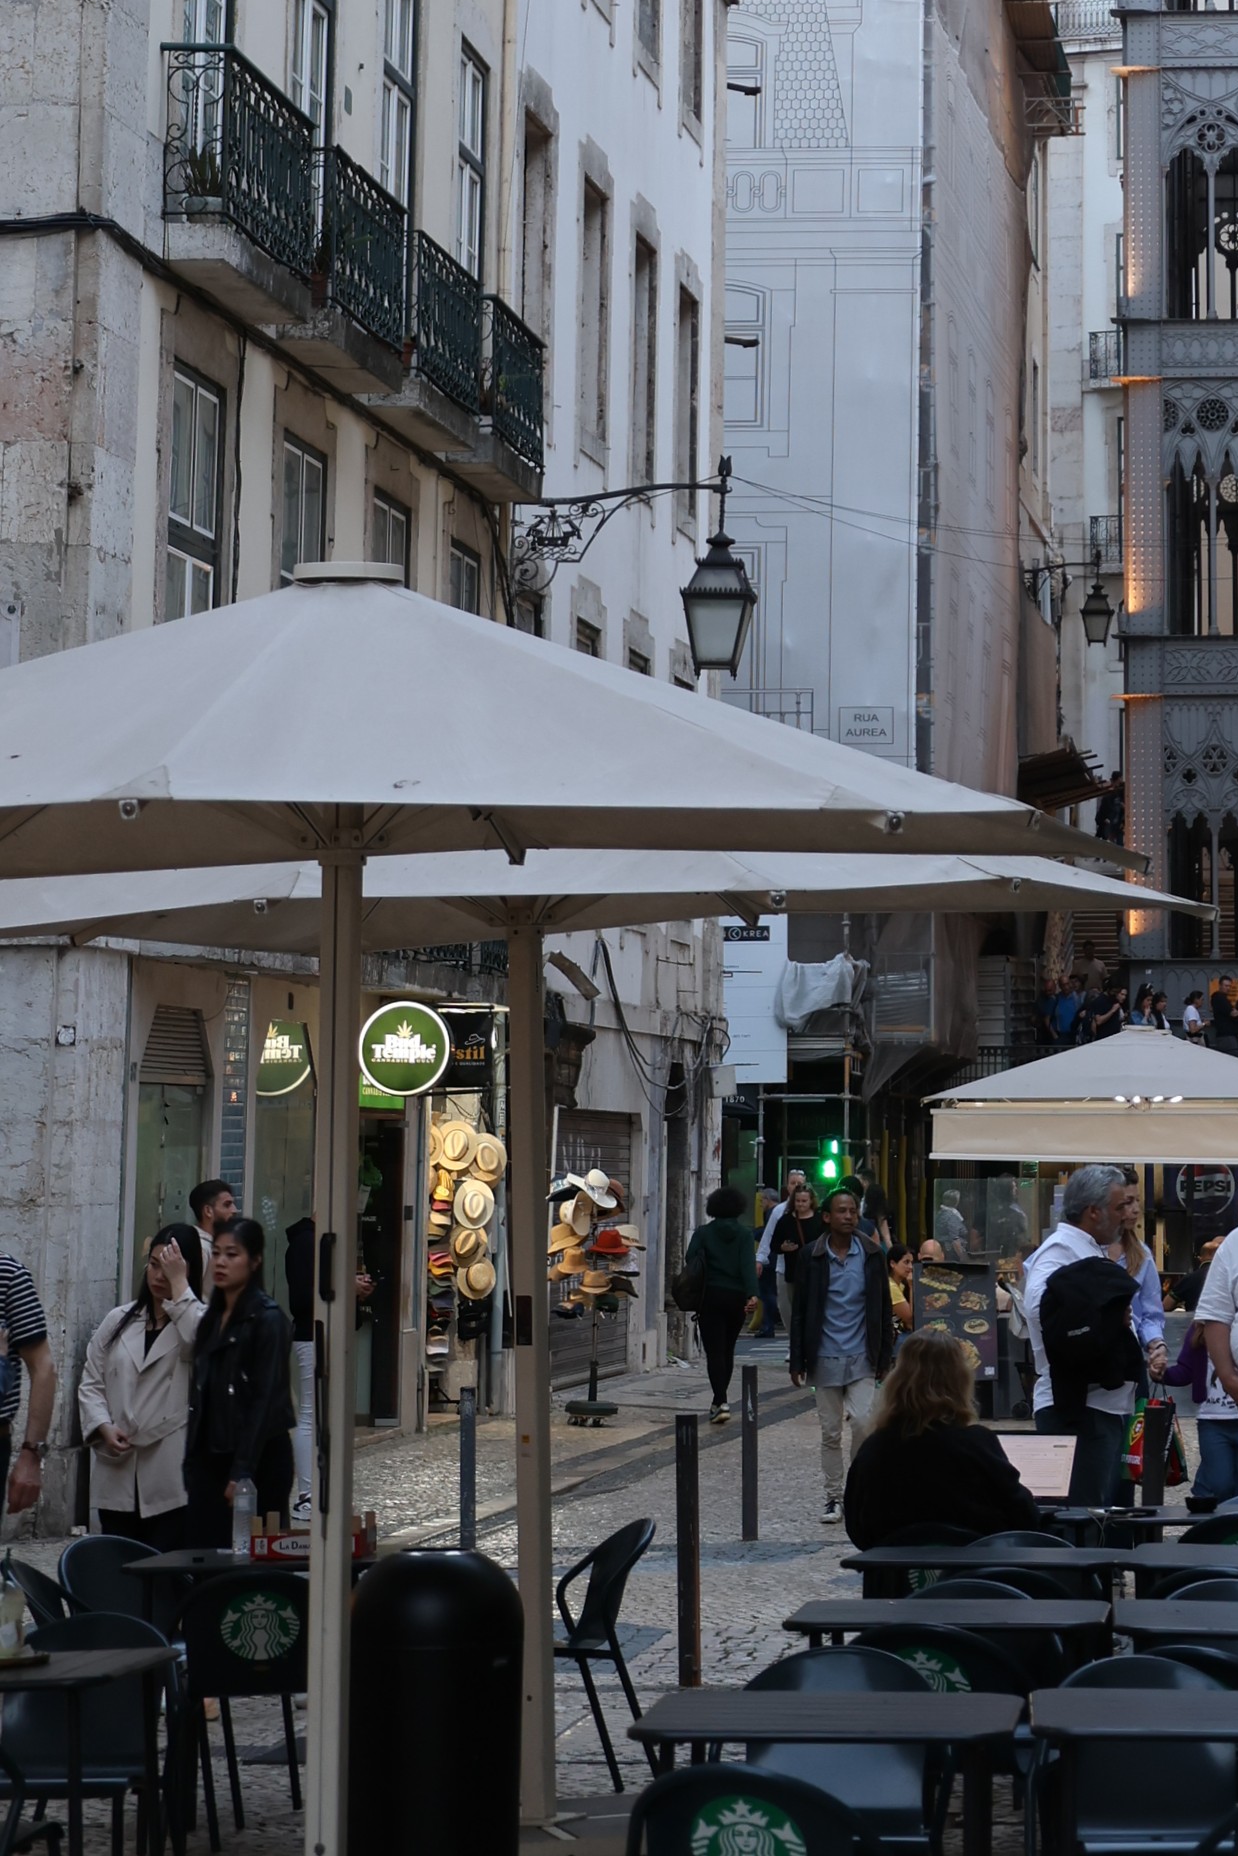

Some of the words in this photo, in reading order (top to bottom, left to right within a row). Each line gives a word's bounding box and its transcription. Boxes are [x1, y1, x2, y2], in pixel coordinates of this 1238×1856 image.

[854, 713, 879, 722] RUA
[845, 727, 887, 737] AUREA
[742, 929, 769, 938] KREA
[385, 1033, 420, 1049] Bud
[371, 1044, 436, 1063] Temple
[452, 1045, 485, 1060] stil
